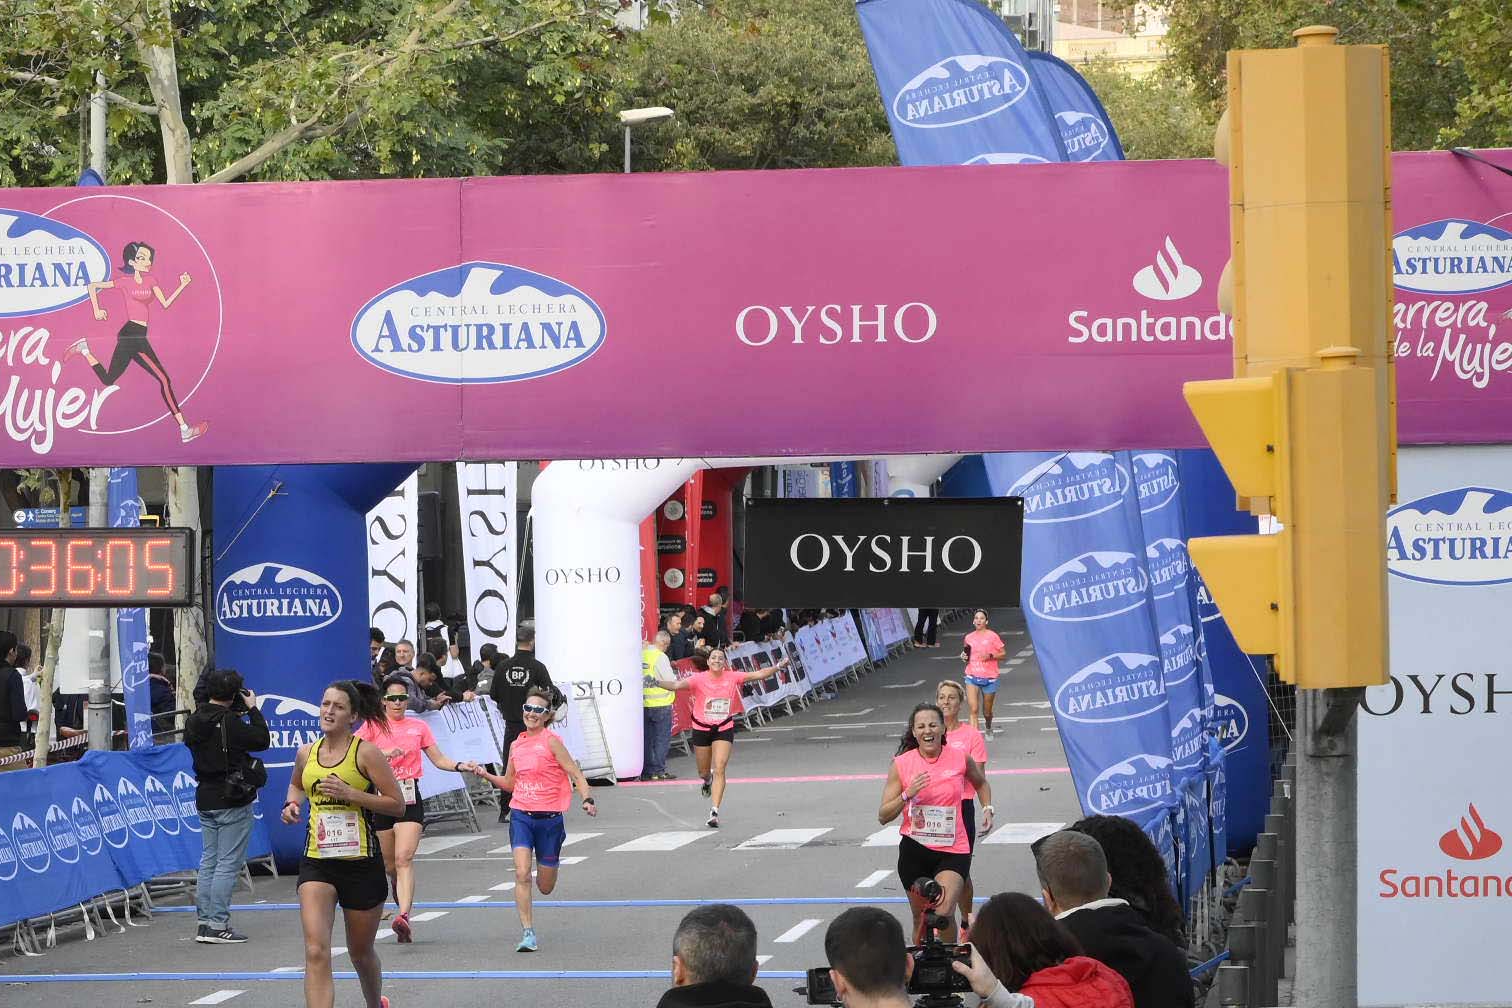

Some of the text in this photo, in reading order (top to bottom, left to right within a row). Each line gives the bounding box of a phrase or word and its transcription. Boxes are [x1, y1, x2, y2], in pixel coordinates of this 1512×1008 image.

[12, 245, 87, 256] LECHERA
[1407, 245, 1457, 253] CENTRAL
[410, 303, 578, 318] CENTRAL LECHERA
[1393, 300, 1488, 329] arrera
[371, 308, 587, 353] ASTURIANA
[735, 302, 938, 346] OYSHO
[1417, 330, 1435, 357] la
[1414, 522, 1481, 532] CENTRAL
[789, 533, 983, 575] OYSHO
[545, 566, 621, 586] OYSHO
[232, 587, 328, 596] CENTRAL LECHERA
[220, 592, 333, 620] ASTURIANA
[511, 671, 525, 680] BP
[576, 679, 623, 697] SHO
